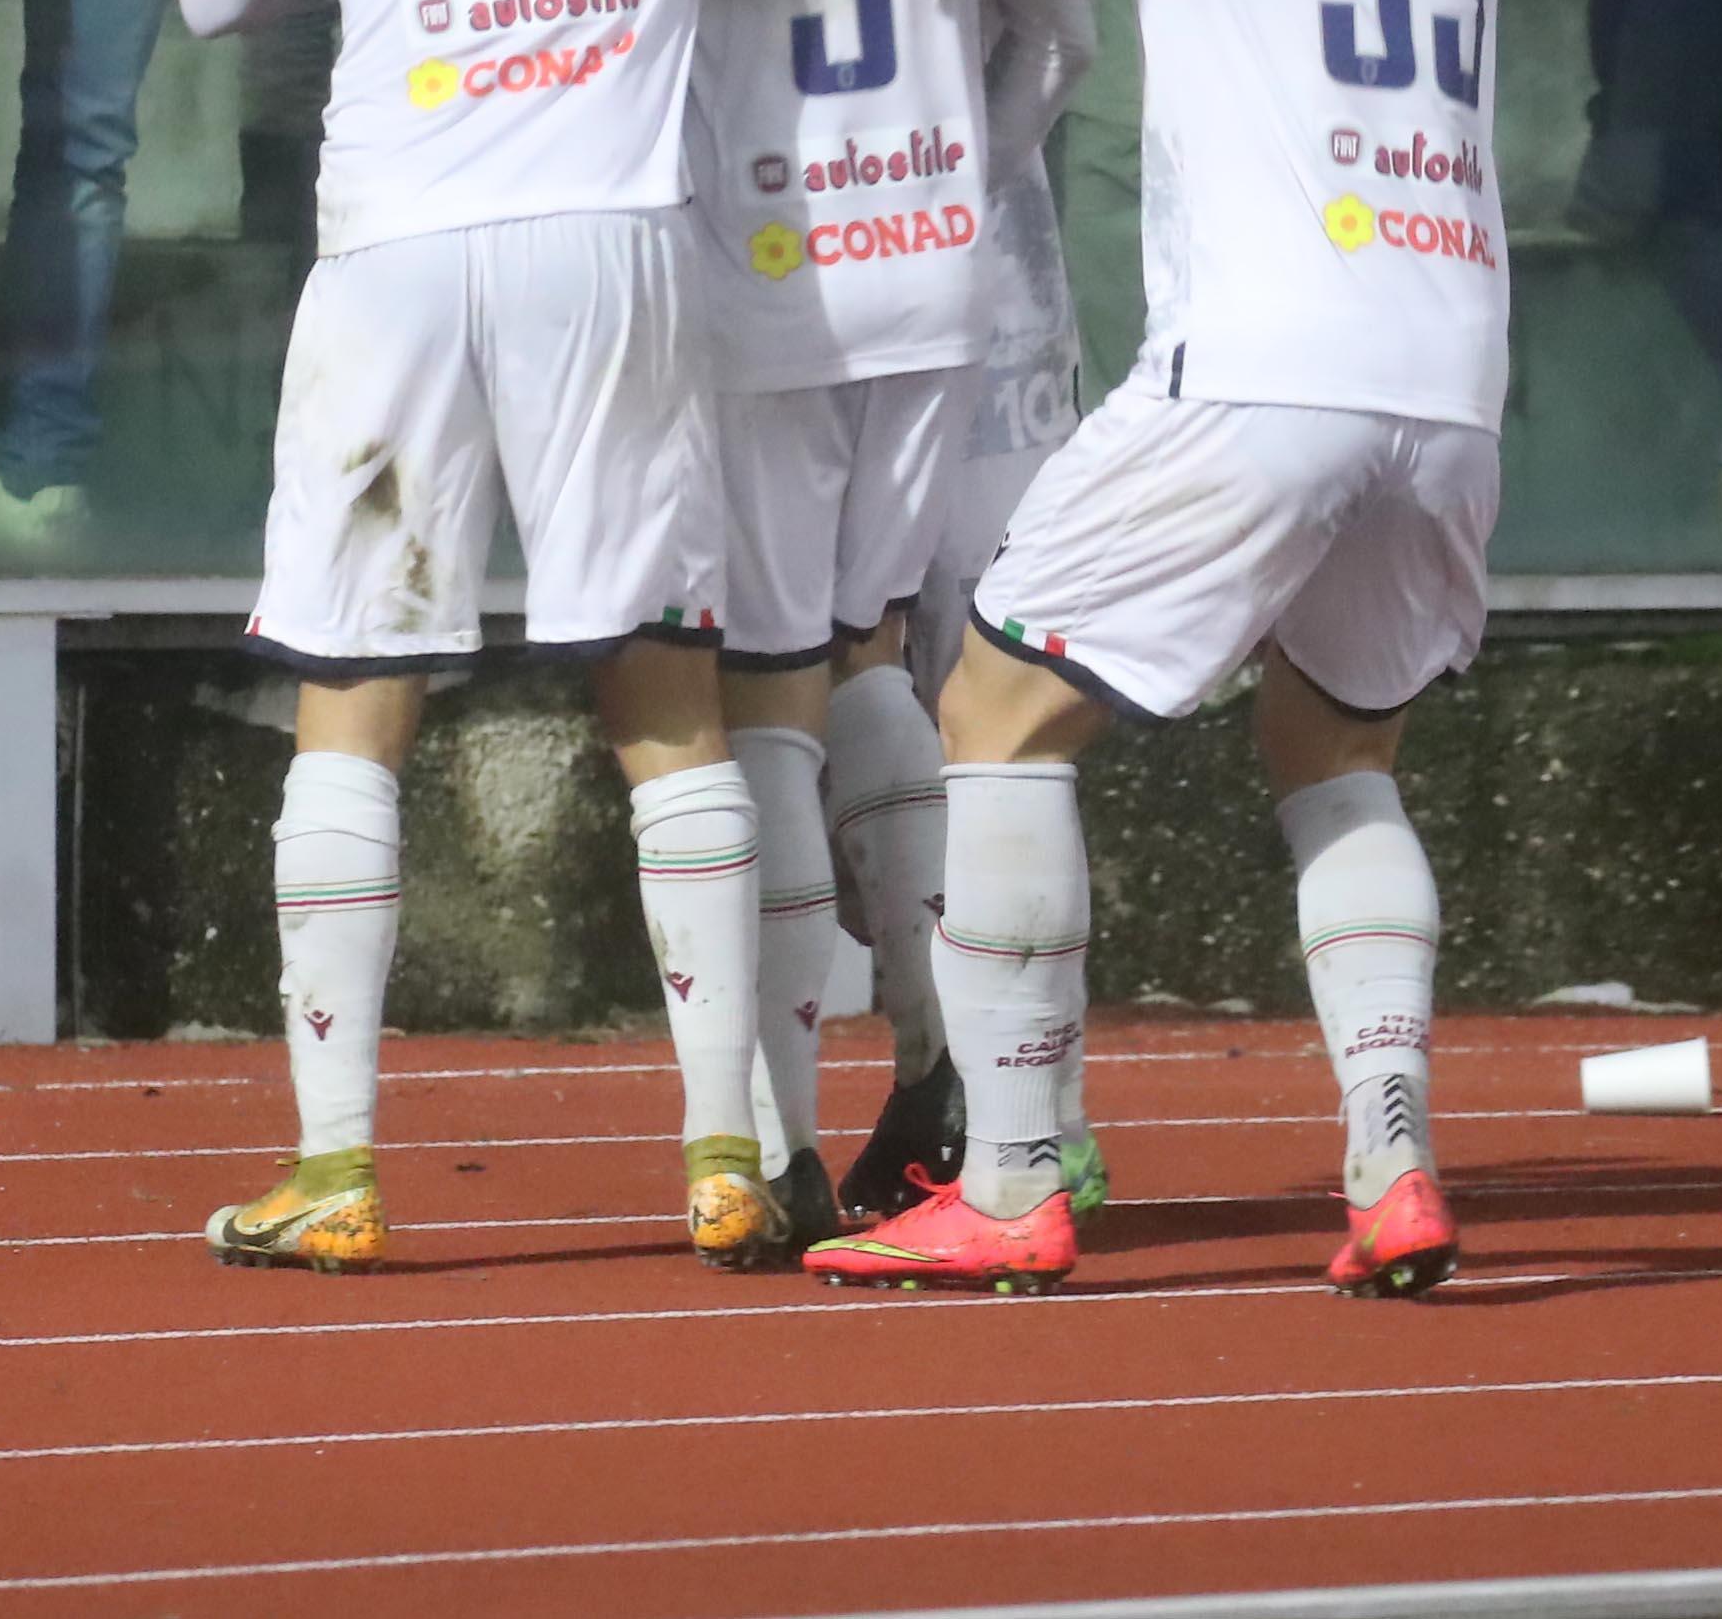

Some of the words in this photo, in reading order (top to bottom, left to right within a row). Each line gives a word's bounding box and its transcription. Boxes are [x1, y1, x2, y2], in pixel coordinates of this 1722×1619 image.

[804, 125, 965, 193] autostile
[806, 204, 975, 266] CONAD
[1379, 209, 1496, 269] CONA
